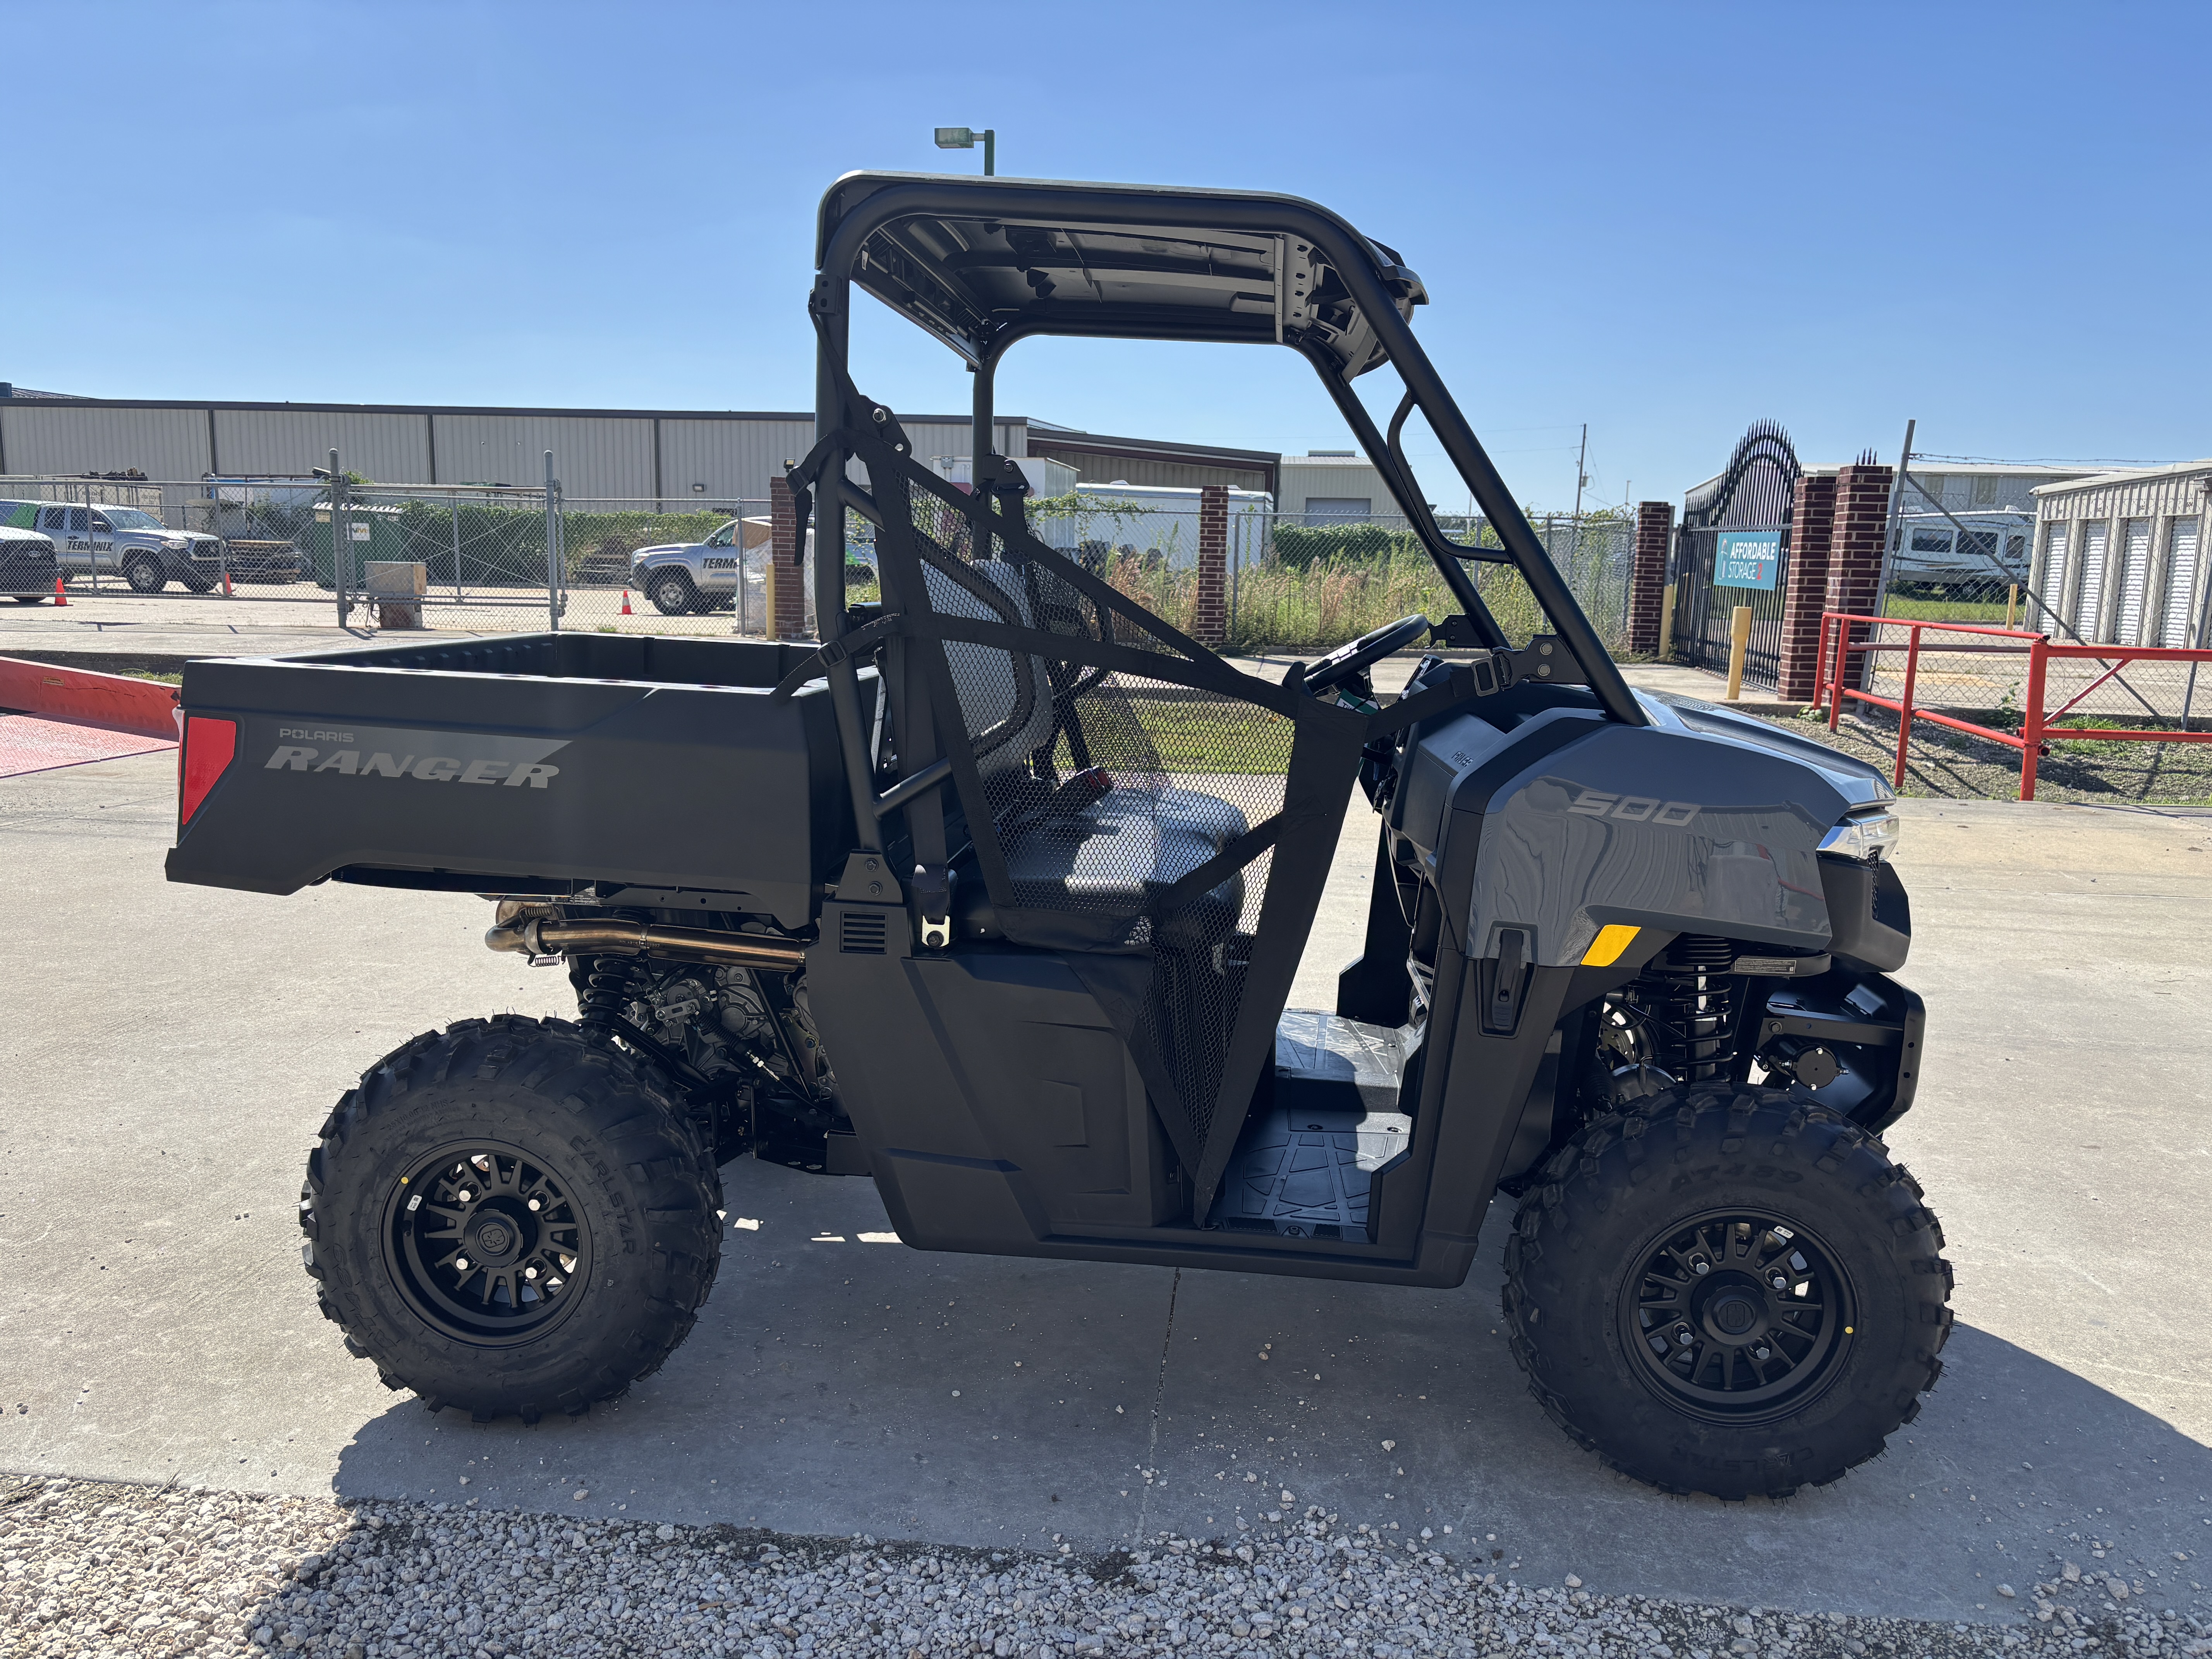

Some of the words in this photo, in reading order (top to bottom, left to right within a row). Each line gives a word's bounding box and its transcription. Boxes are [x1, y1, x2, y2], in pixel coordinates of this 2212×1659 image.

[1730, 542, 1776, 560] AFFORDABLE
[1728, 562, 1757, 579] STORAGE
[1757, 563, 1762, 580] 2
[280, 728, 354, 742] POLARIS
[264, 745, 560, 788] RANGER
[1566, 790, 1702, 826] 500
[569, 1135, 637, 1254] CARLSTAR
[1669, 1163, 1804, 1193] AT489
[333, 1243, 397, 1348] AT489
